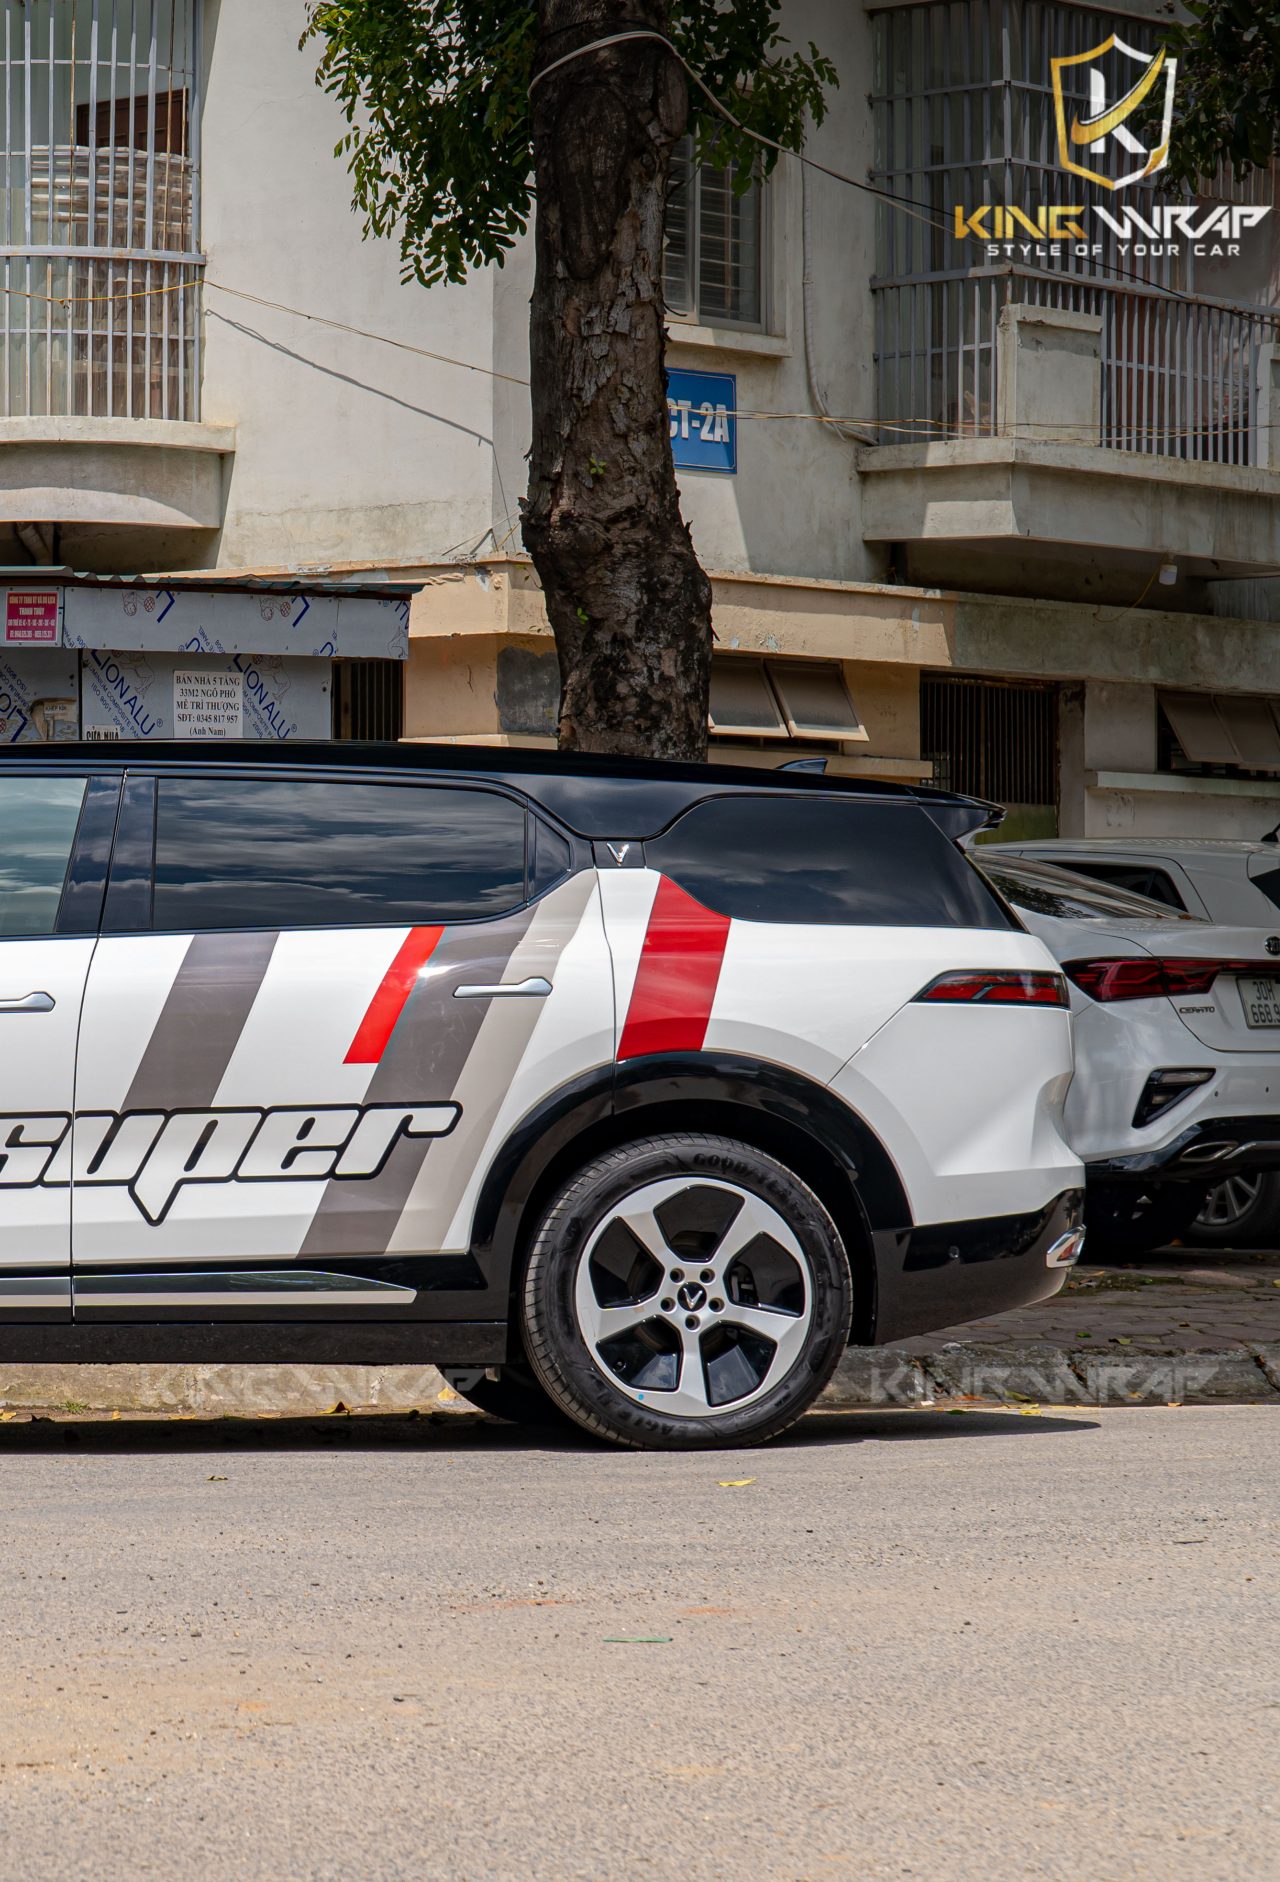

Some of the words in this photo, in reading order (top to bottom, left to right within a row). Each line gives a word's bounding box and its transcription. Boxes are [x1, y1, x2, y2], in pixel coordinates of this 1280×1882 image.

[180, 689, 198, 697] 33M2
[197, 714, 212, 723] 0345
[214, 715, 225, 723] 817
